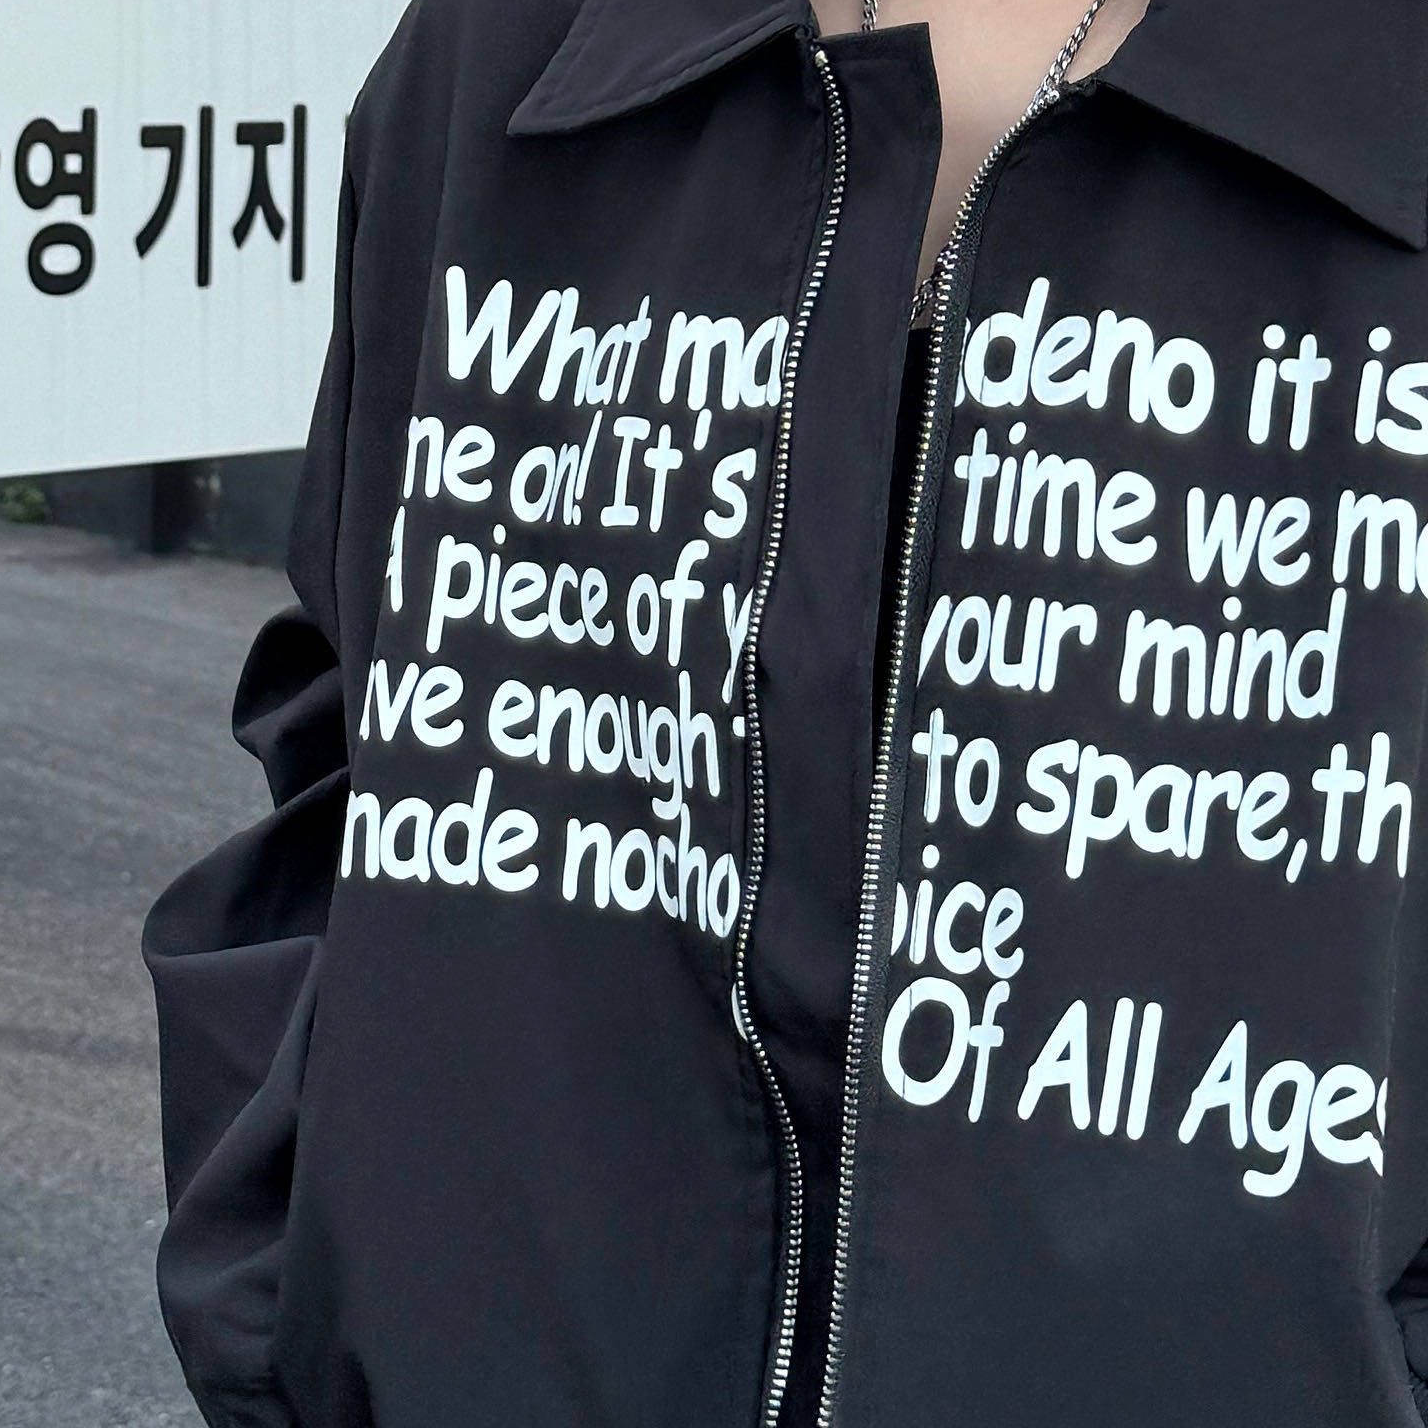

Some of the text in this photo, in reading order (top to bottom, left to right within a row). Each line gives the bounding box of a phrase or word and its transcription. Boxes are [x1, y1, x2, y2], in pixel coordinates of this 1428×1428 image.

[135, 105, 307, 287] 기지
[446, 266, 651, 406] What
[1248, 325, 1331, 450] it
[601, 409, 756, 538] It's
[955, 422, 1157, 565] time
[1187, 487, 1310, 587] we
[426, 524, 614, 653] piece
[627, 540, 709, 666] of
[1119, 588, 1346, 721] mind
[488, 671, 720, 820] enough
[912, 708, 999, 827] to
[882, 977, 1010, 1122] Of
[1018, 998, 1162, 1140] All
